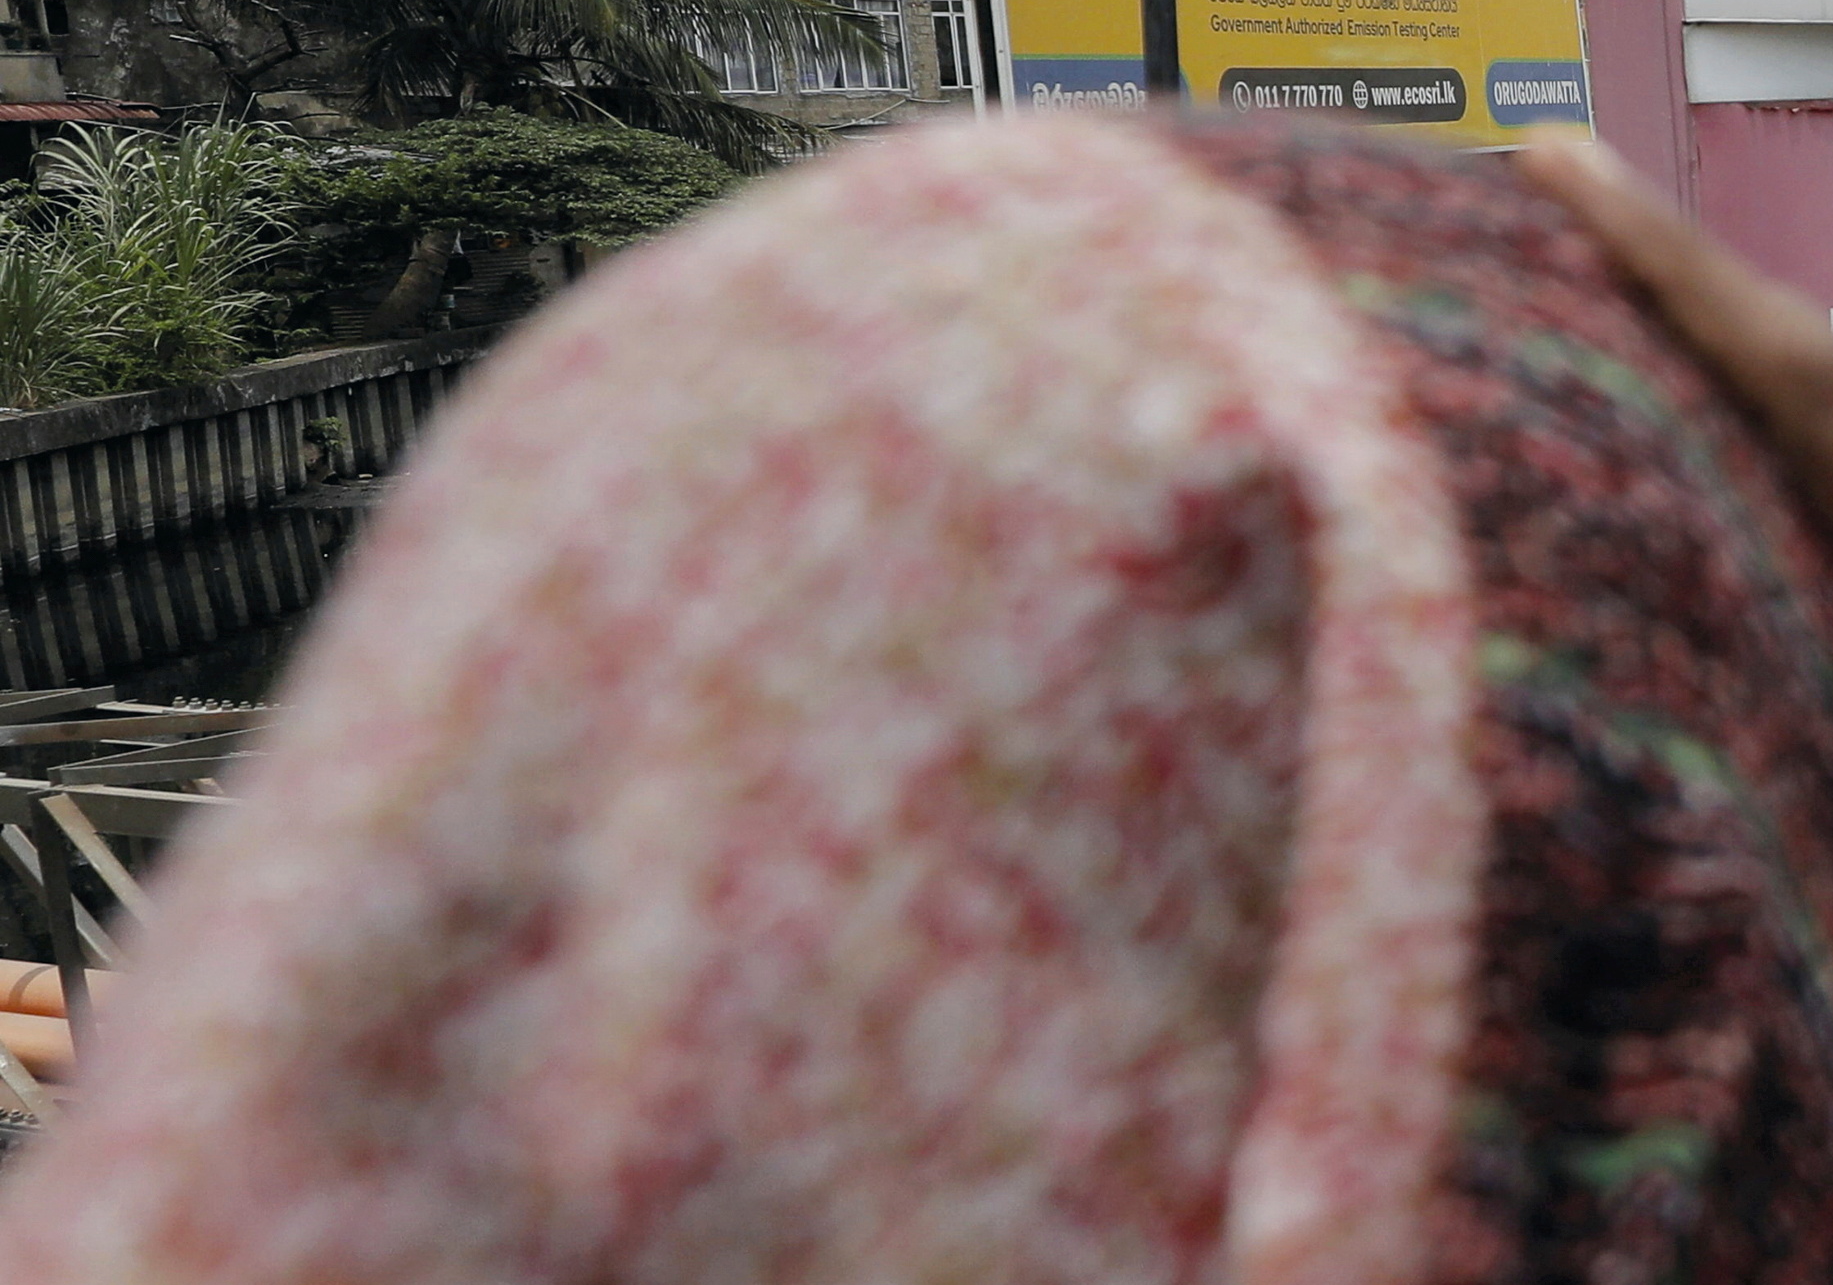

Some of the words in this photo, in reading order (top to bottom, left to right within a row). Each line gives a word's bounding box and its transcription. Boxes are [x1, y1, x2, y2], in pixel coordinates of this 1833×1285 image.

[1210, 15, 1284, 34] Government
[1285, 18, 1343, 36] Authorized
[1347, 20, 1391, 38] Emission
[1392, 21, 1429, 41] Testing
[1429, 23, 1461, 39] Center
[1371, 79, 1457, 107] www.ecosri.lk
[1493, 80, 1582, 106] ORUGODAWATTA
